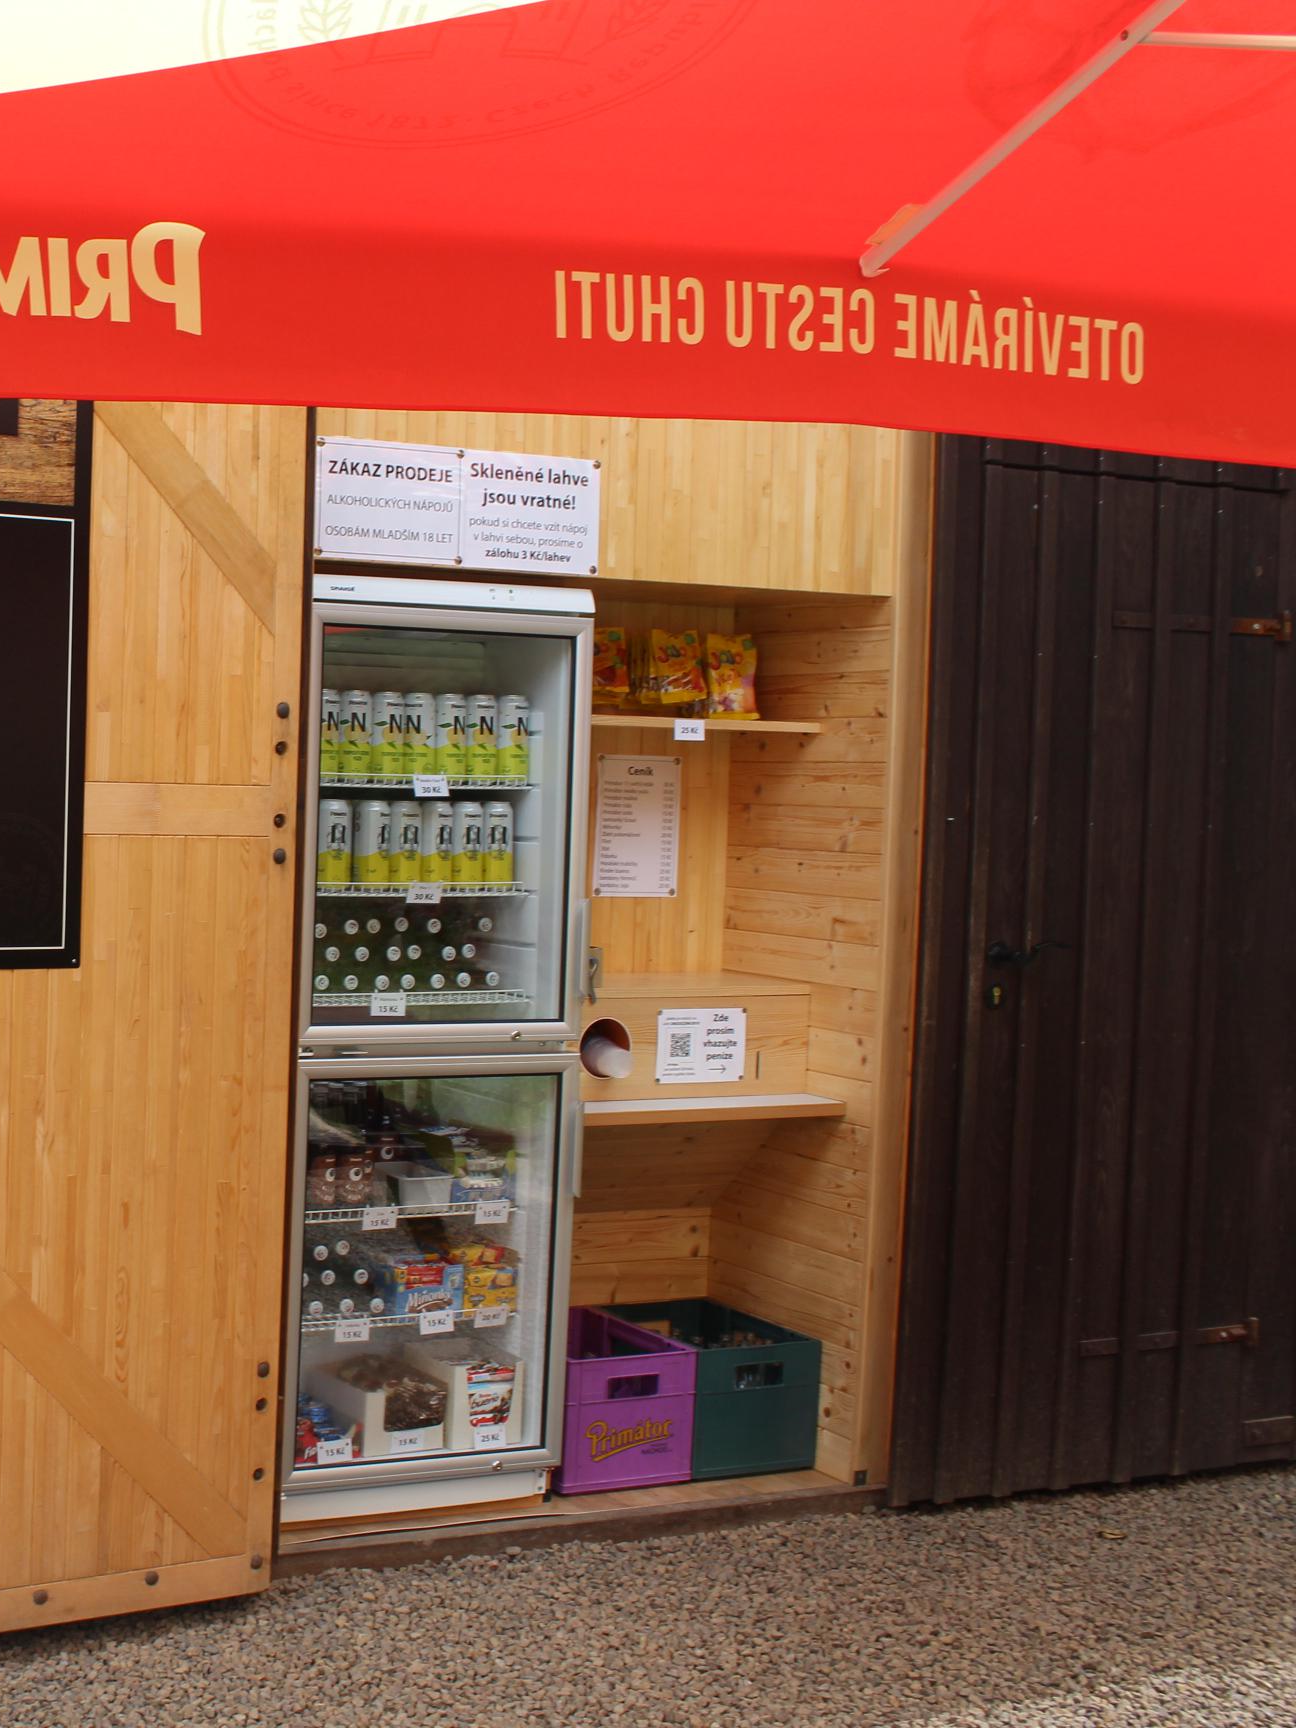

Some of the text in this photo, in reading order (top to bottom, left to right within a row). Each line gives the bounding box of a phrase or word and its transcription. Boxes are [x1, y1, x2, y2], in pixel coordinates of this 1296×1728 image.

[328, 458, 453, 482] ZÁKAZ PRODEJE
[470, 462, 589, 486] Skleněné lahve
[326, 494, 411, 509] ALKOHOLICKÝCH
[482, 488, 576, 510] jsou vratné!
[469, 516, 500, 527] pokud
[502, 518, 510, 528] si
[511, 519, 542, 530] chcete
[324, 525, 453, 543] OSOBÁM MLADŠÍM 18 LET
[473, 532, 480, 540] v
[481, 531, 504, 542] lahvi
[505, 534, 536, 546] sebou,
[577, 540, 584, 548] o
[485, 547, 572, 562] zálohu 3 Kč/lahev
[422, 786, 432, 794] 30
[379, 1005, 387, 1013] 15
[713, 1013, 729, 1022] Zde
[703, 1040, 737, 1049] vhazujte
[427, 1319, 436, 1327] 15
[481, 1434, 491, 1443] 25
[325, 1449, 334, 1457] 15
